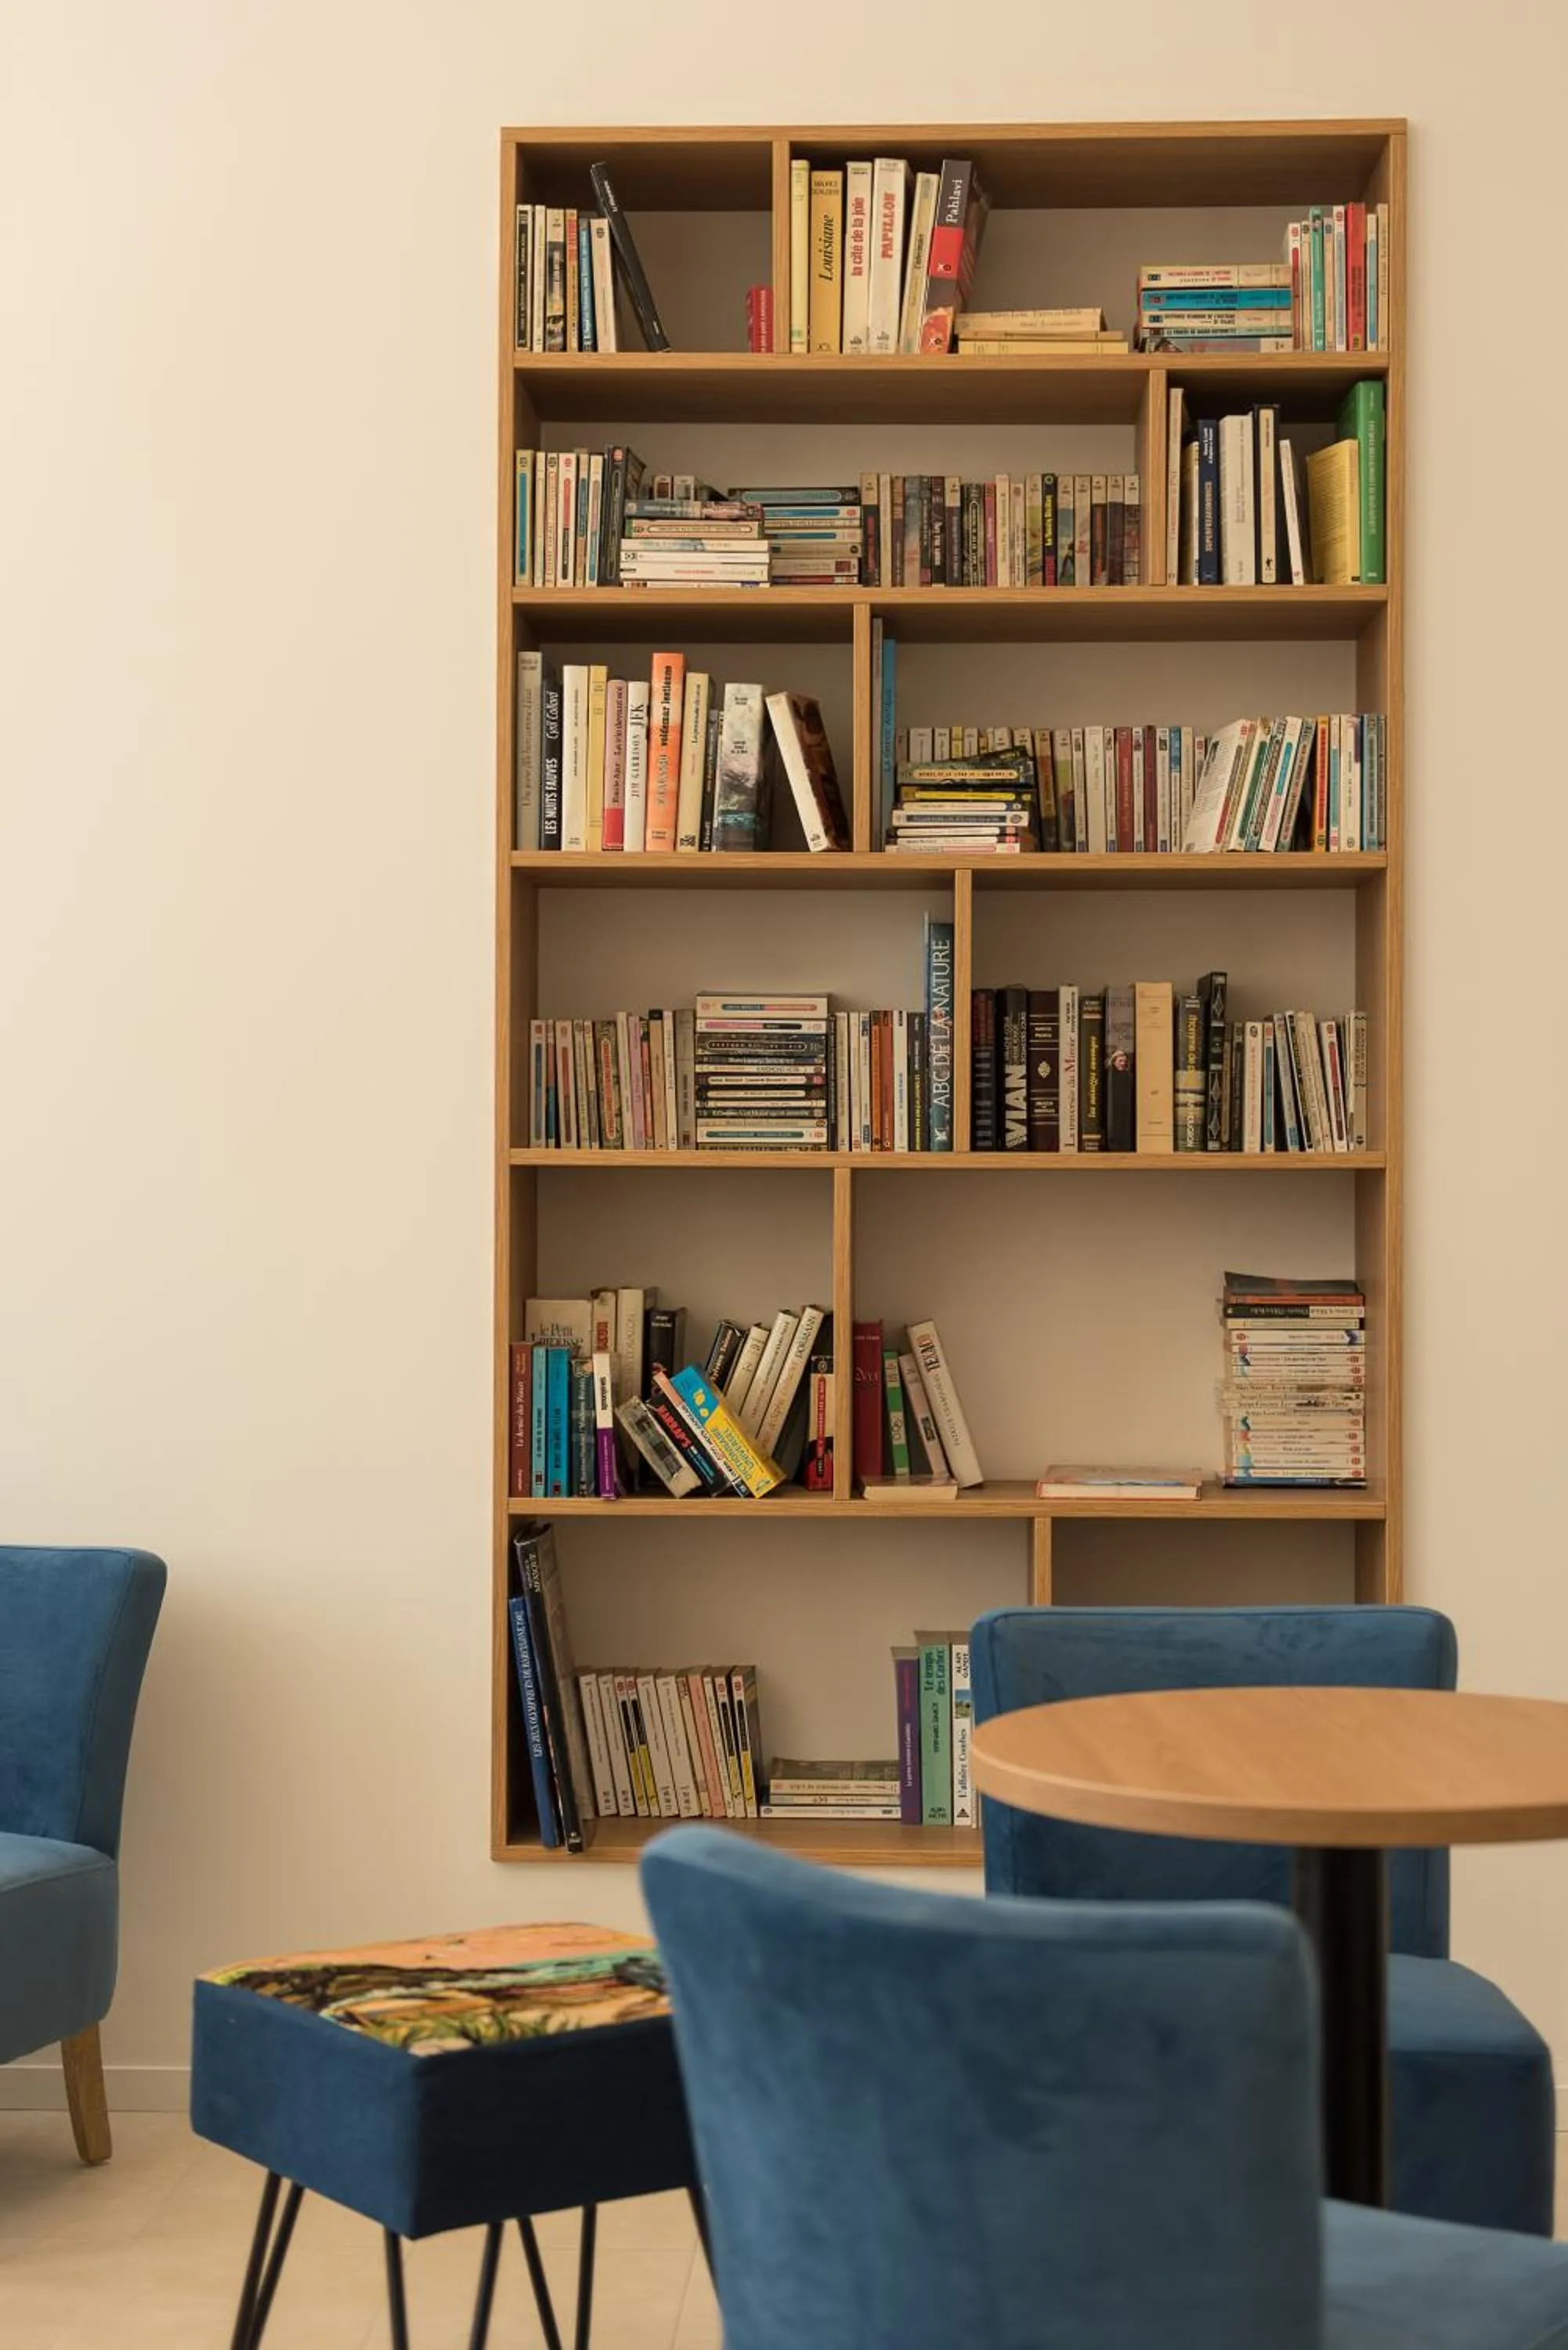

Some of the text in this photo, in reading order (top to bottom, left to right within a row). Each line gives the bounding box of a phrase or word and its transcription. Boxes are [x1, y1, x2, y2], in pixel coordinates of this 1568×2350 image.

[945, 179, 963, 223] Pahlavi
[851, 197, 865, 276] la cité de la joie
[880, 192, 895, 259] PAPILLON
[818, 215, 834, 281] Louisiane
[661, 665, 672, 704] lestienne
[629, 703, 645, 728] JFK
[660, 707, 670, 747] voldemar
[545, 757, 558, 790] FAUVES
[545, 792, 558, 818] NUITS
[545, 820, 557, 834] LES
[933, 939, 952, 1108] ABC DE LA NATURE
[1064, 1036, 1075, 1072] Miroir
[1065, 1076, 1075, 1084] du
[1005, 1064, 1027, 1142] VIAN
[1064, 1133, 1075, 1147] La
[551, 1324, 573, 1336] Petit
[916, 1332, 941, 1373] TEXACO
[923, 1652, 935, 1691] Le temps
[936, 1679, 945, 1694] des
[529, 1724, 540, 1743] JEUX
[531, 1743, 542, 1757] LES
[958, 1764, 967, 1798] L'affaire
